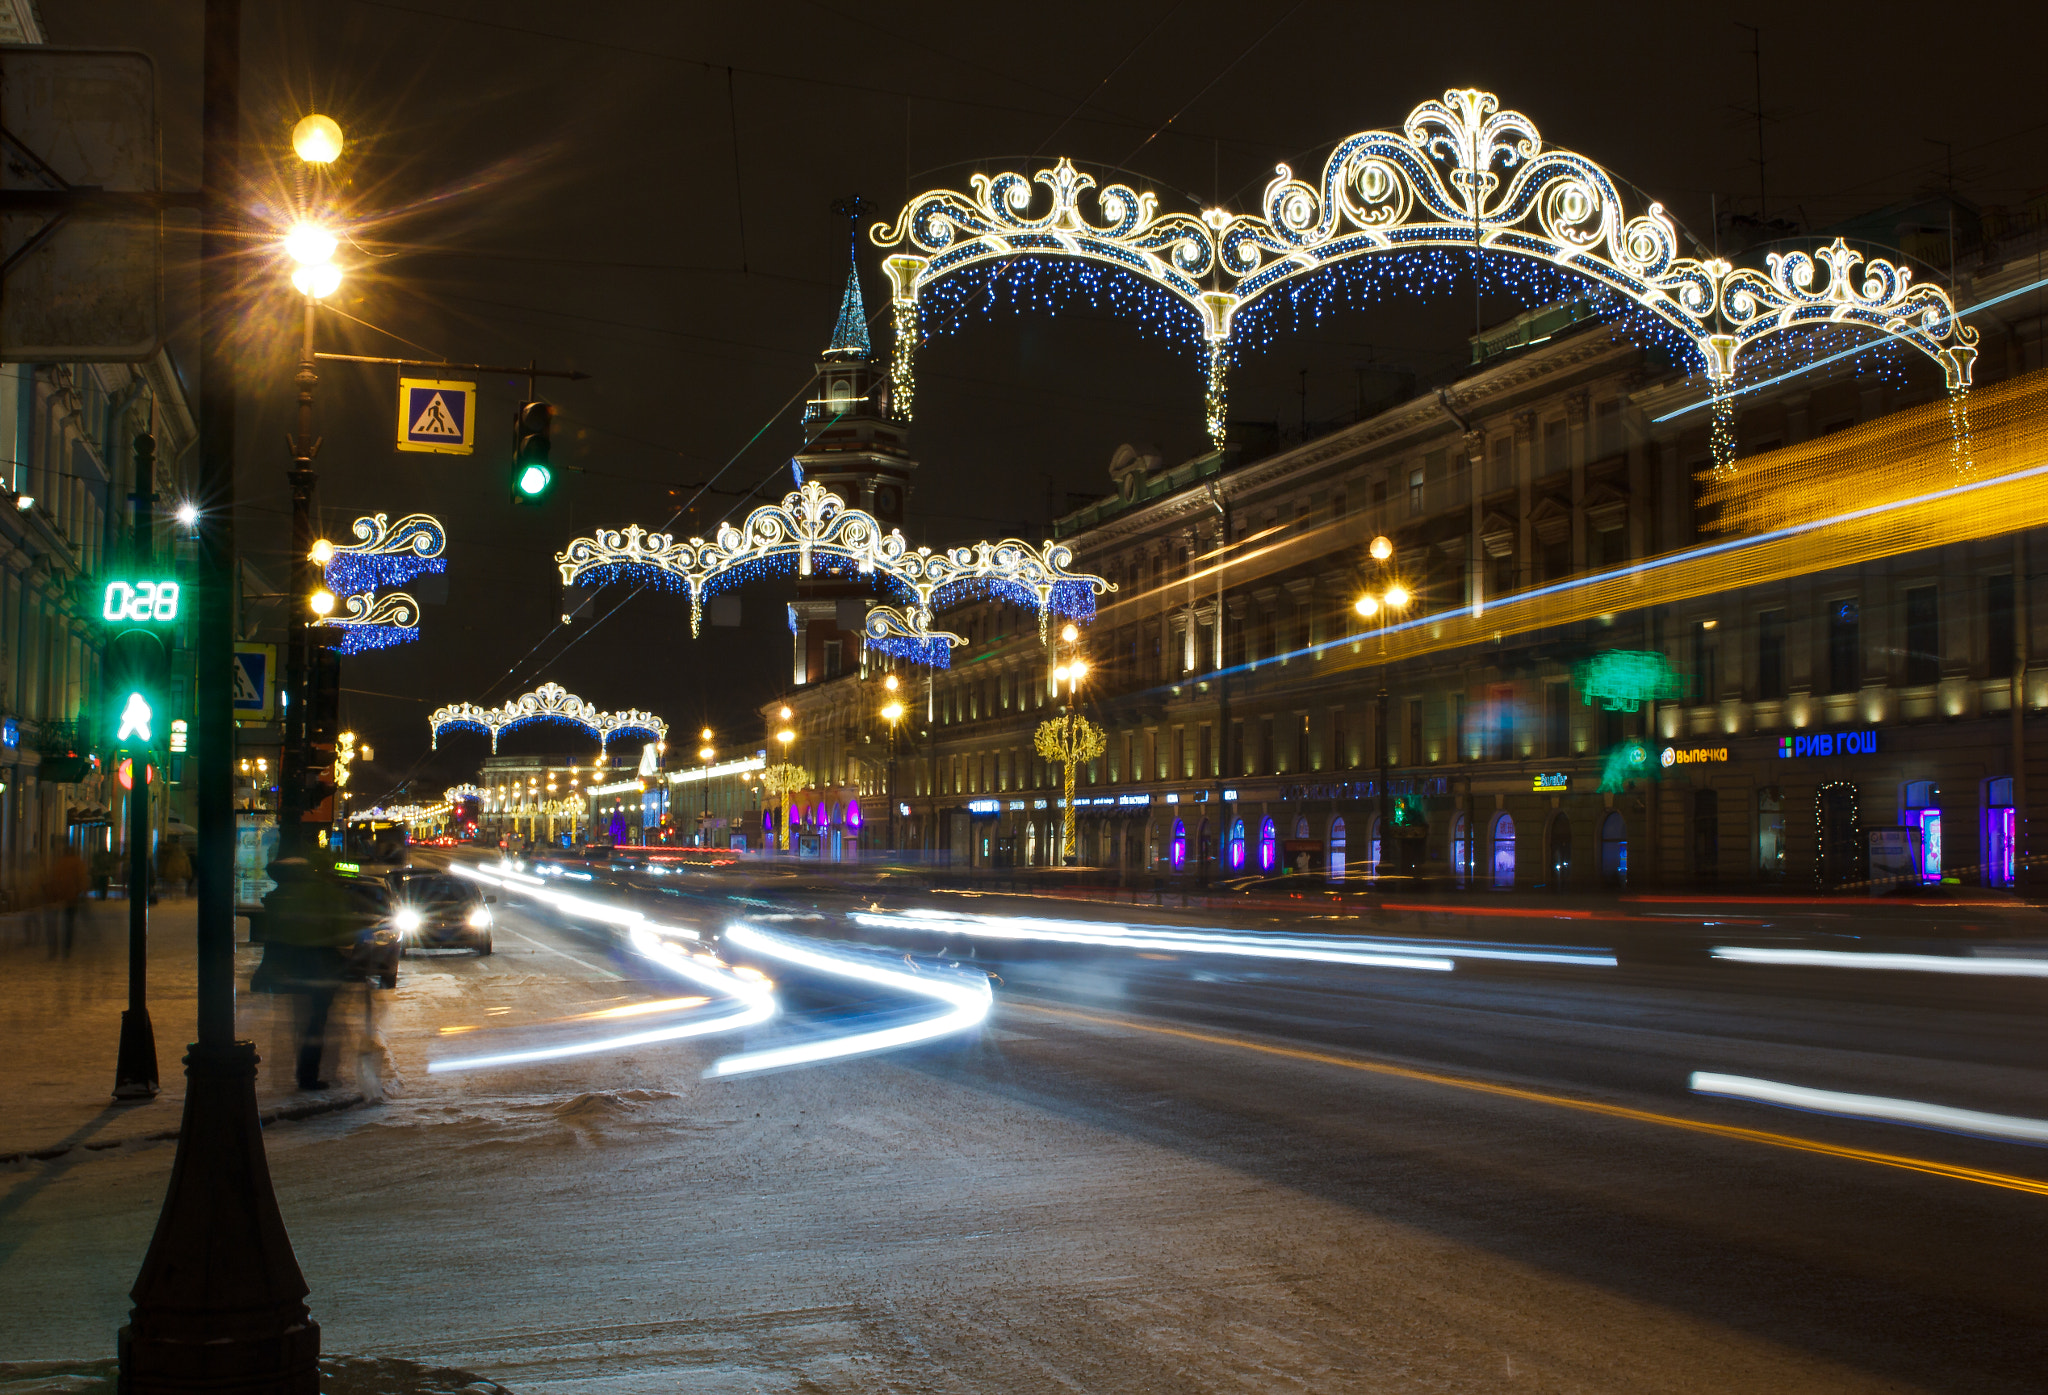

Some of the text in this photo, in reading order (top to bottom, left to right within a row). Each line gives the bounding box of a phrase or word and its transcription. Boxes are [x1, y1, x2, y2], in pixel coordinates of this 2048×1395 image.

[103, 581, 179, 621] 0:28
[1676, 747, 1728, 764] выпечка
[1795, 730, 1877, 757] РИВ ГОШ
